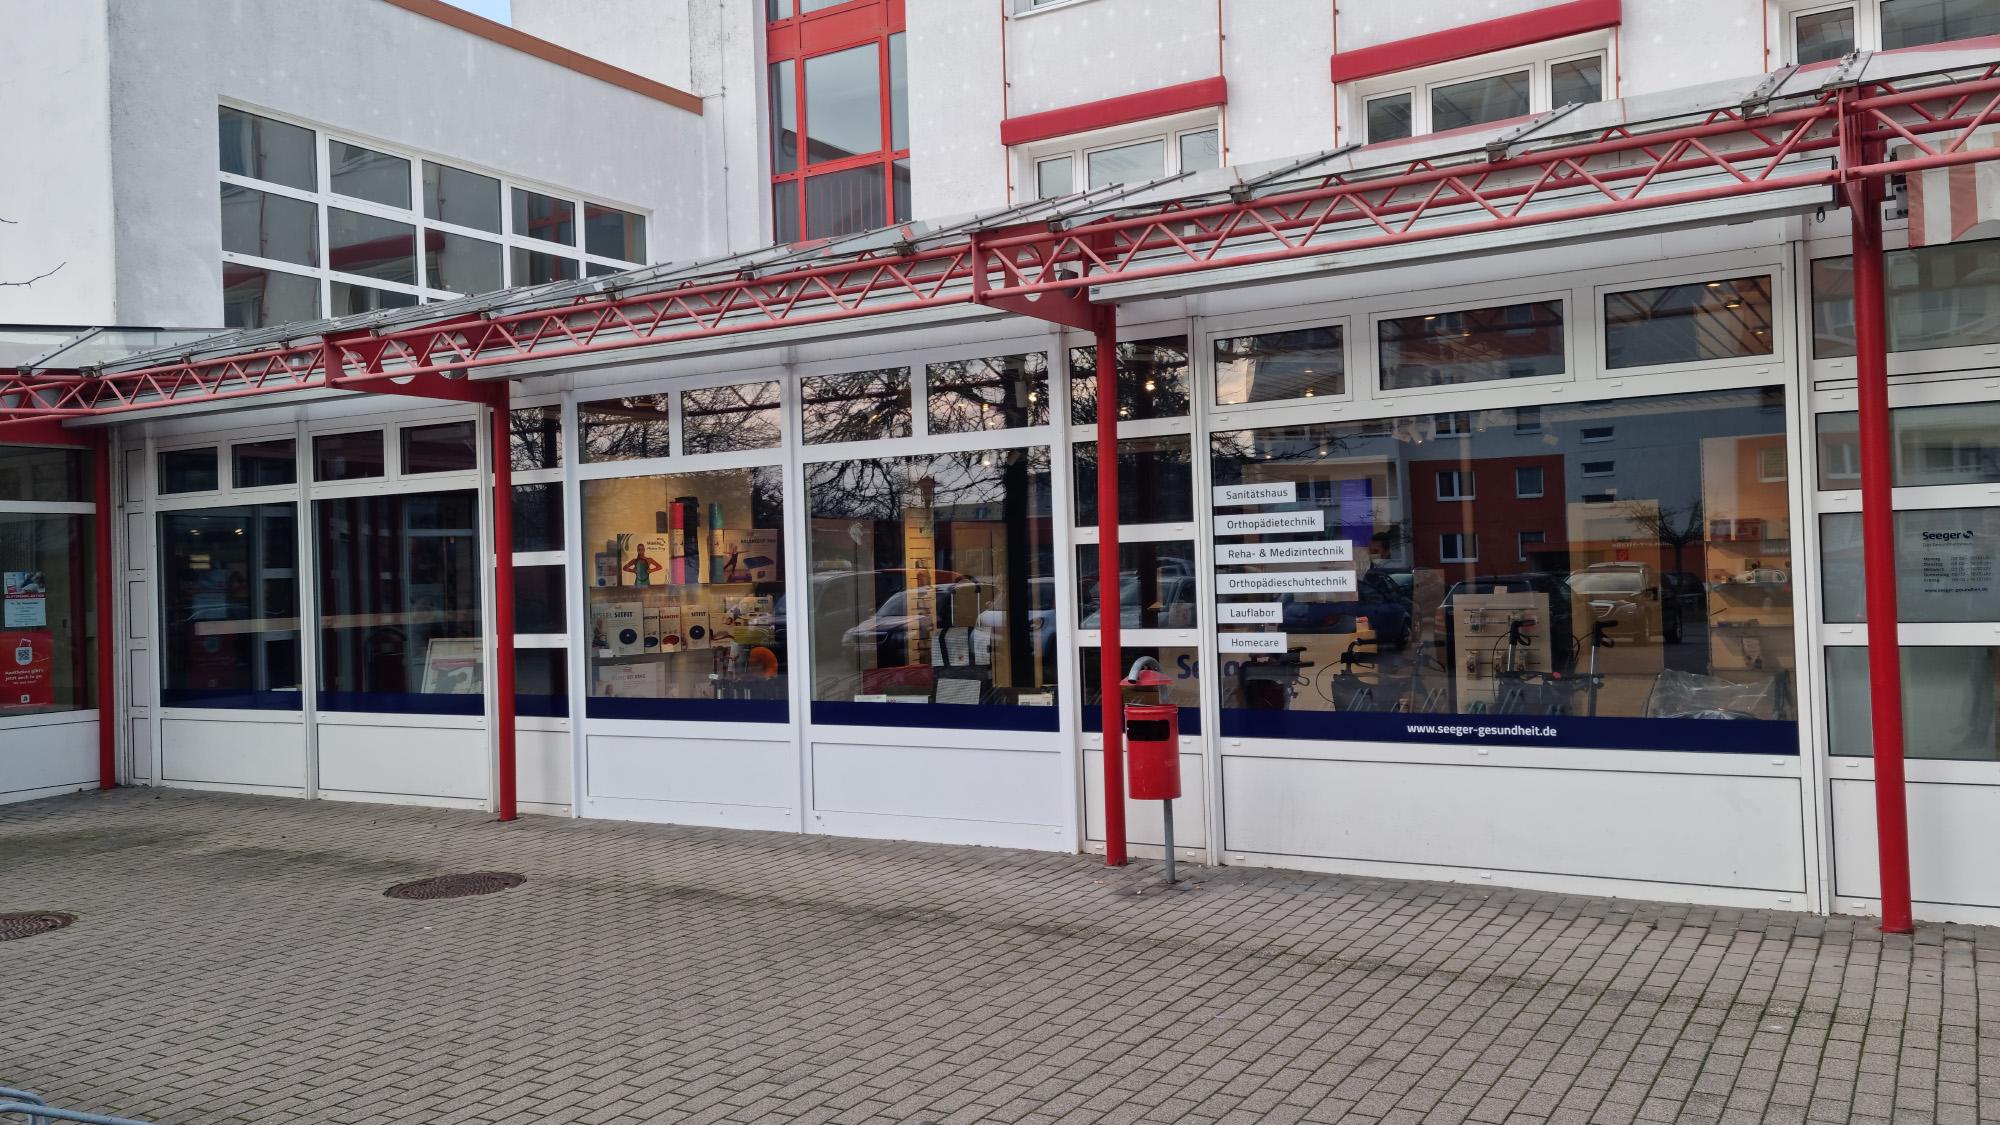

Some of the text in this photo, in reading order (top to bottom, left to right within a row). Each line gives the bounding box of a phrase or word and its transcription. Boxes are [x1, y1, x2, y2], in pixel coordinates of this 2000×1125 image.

[1226, 489, 1288, 500] Sanitätshaus
[1227, 516, 1316, 530] Orthopädietechnik
[1922, 531, 1962, 541] Seeger
[1228, 546, 1344, 559] Reha- & Medizintechnik
[1229, 576, 1347, 589] Orthopädieschuhtechnik
[1230, 608, 1276, 618] Lauflabor
[1231, 638, 1279, 648] Homecare
[1407, 724, 1557, 737] www.seeger-gesundheit.de
